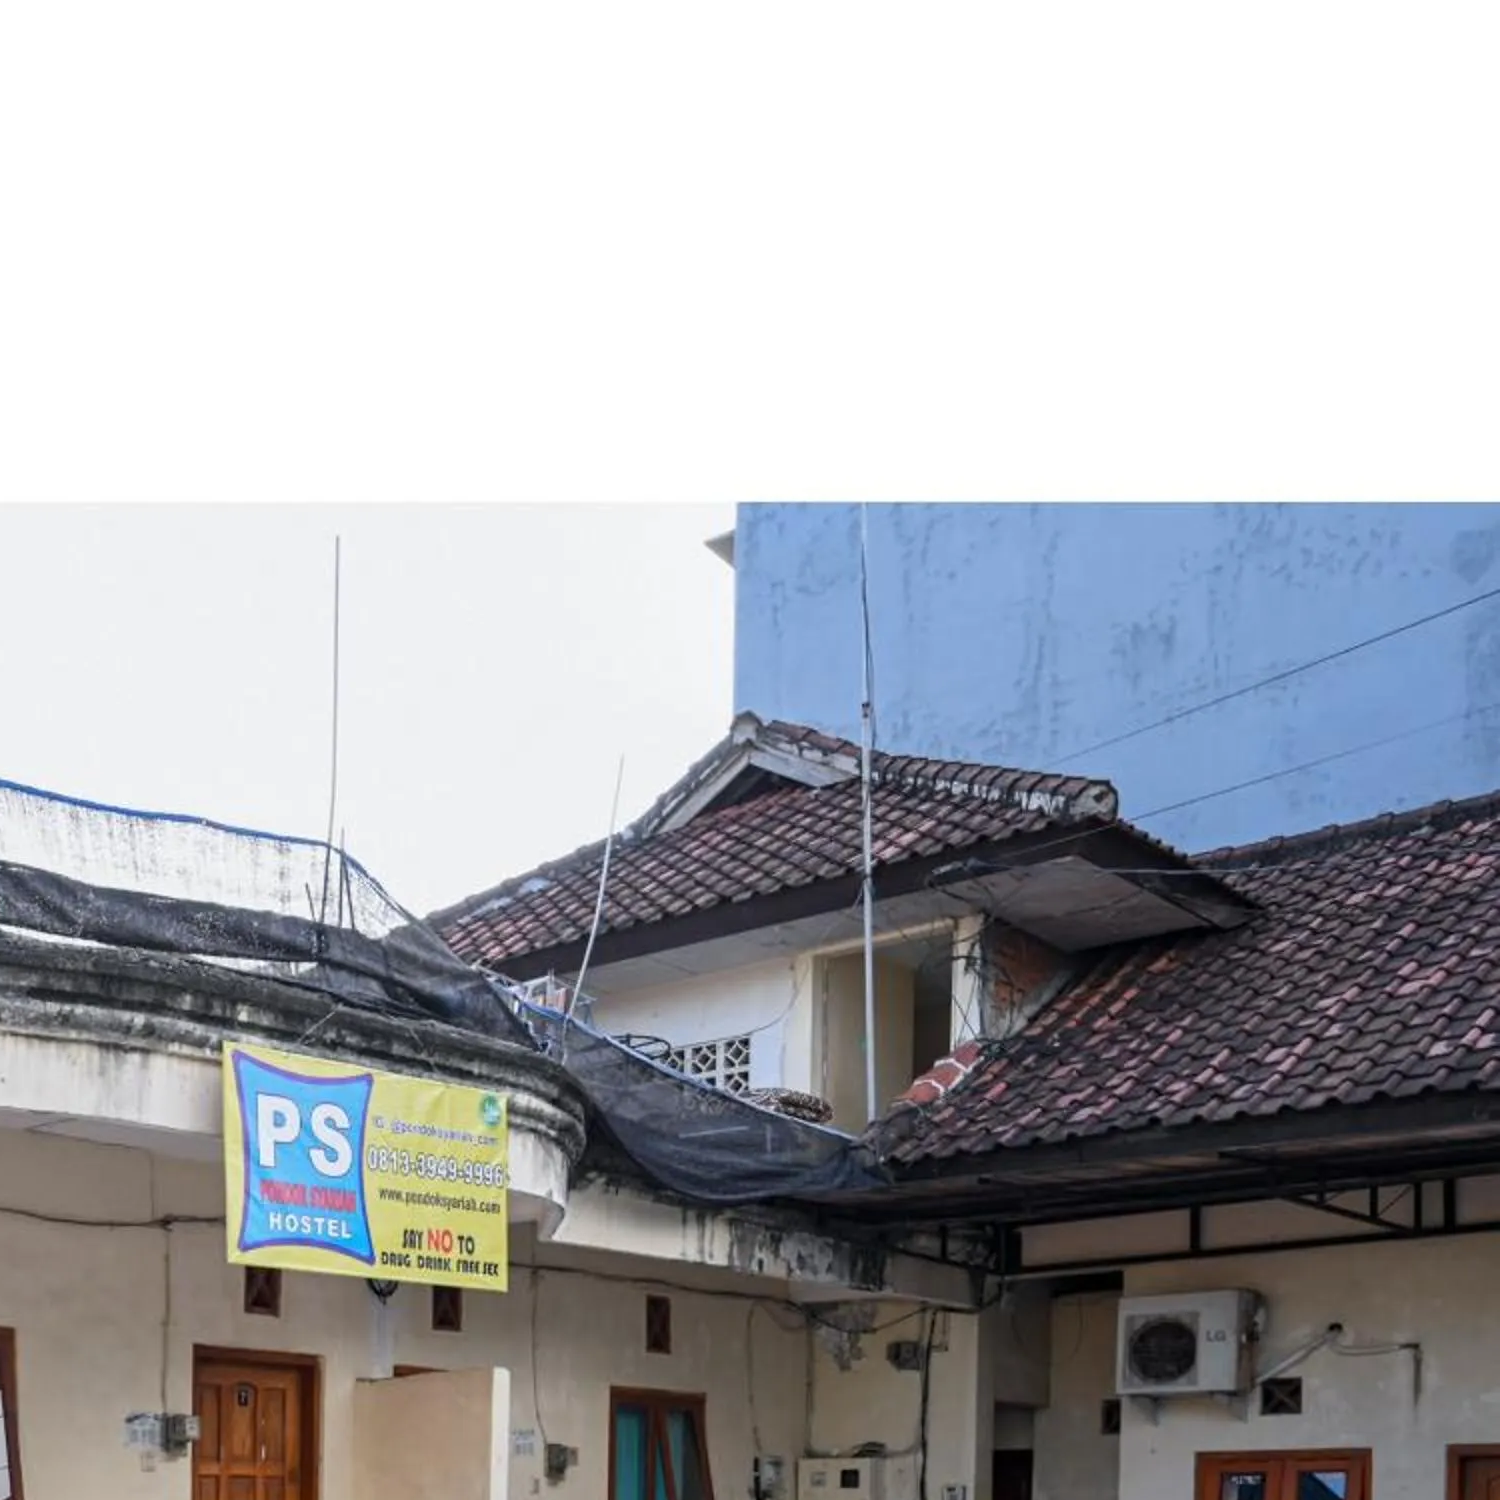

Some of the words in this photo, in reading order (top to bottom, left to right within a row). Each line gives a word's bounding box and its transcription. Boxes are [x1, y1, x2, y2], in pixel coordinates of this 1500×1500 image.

[256, 1092, 351, 1178] PS
[268, 1211, 352, 1239] HOSTEL
[402, 1228, 423, 1250] SAY
[427, 1228, 453, 1254] NO
[457, 1235, 475, 1256] TO
[380, 1251, 411, 1268] DRUG
[417, 1255, 451, 1272] DRINK
[457, 1259, 480, 1275] FREE
